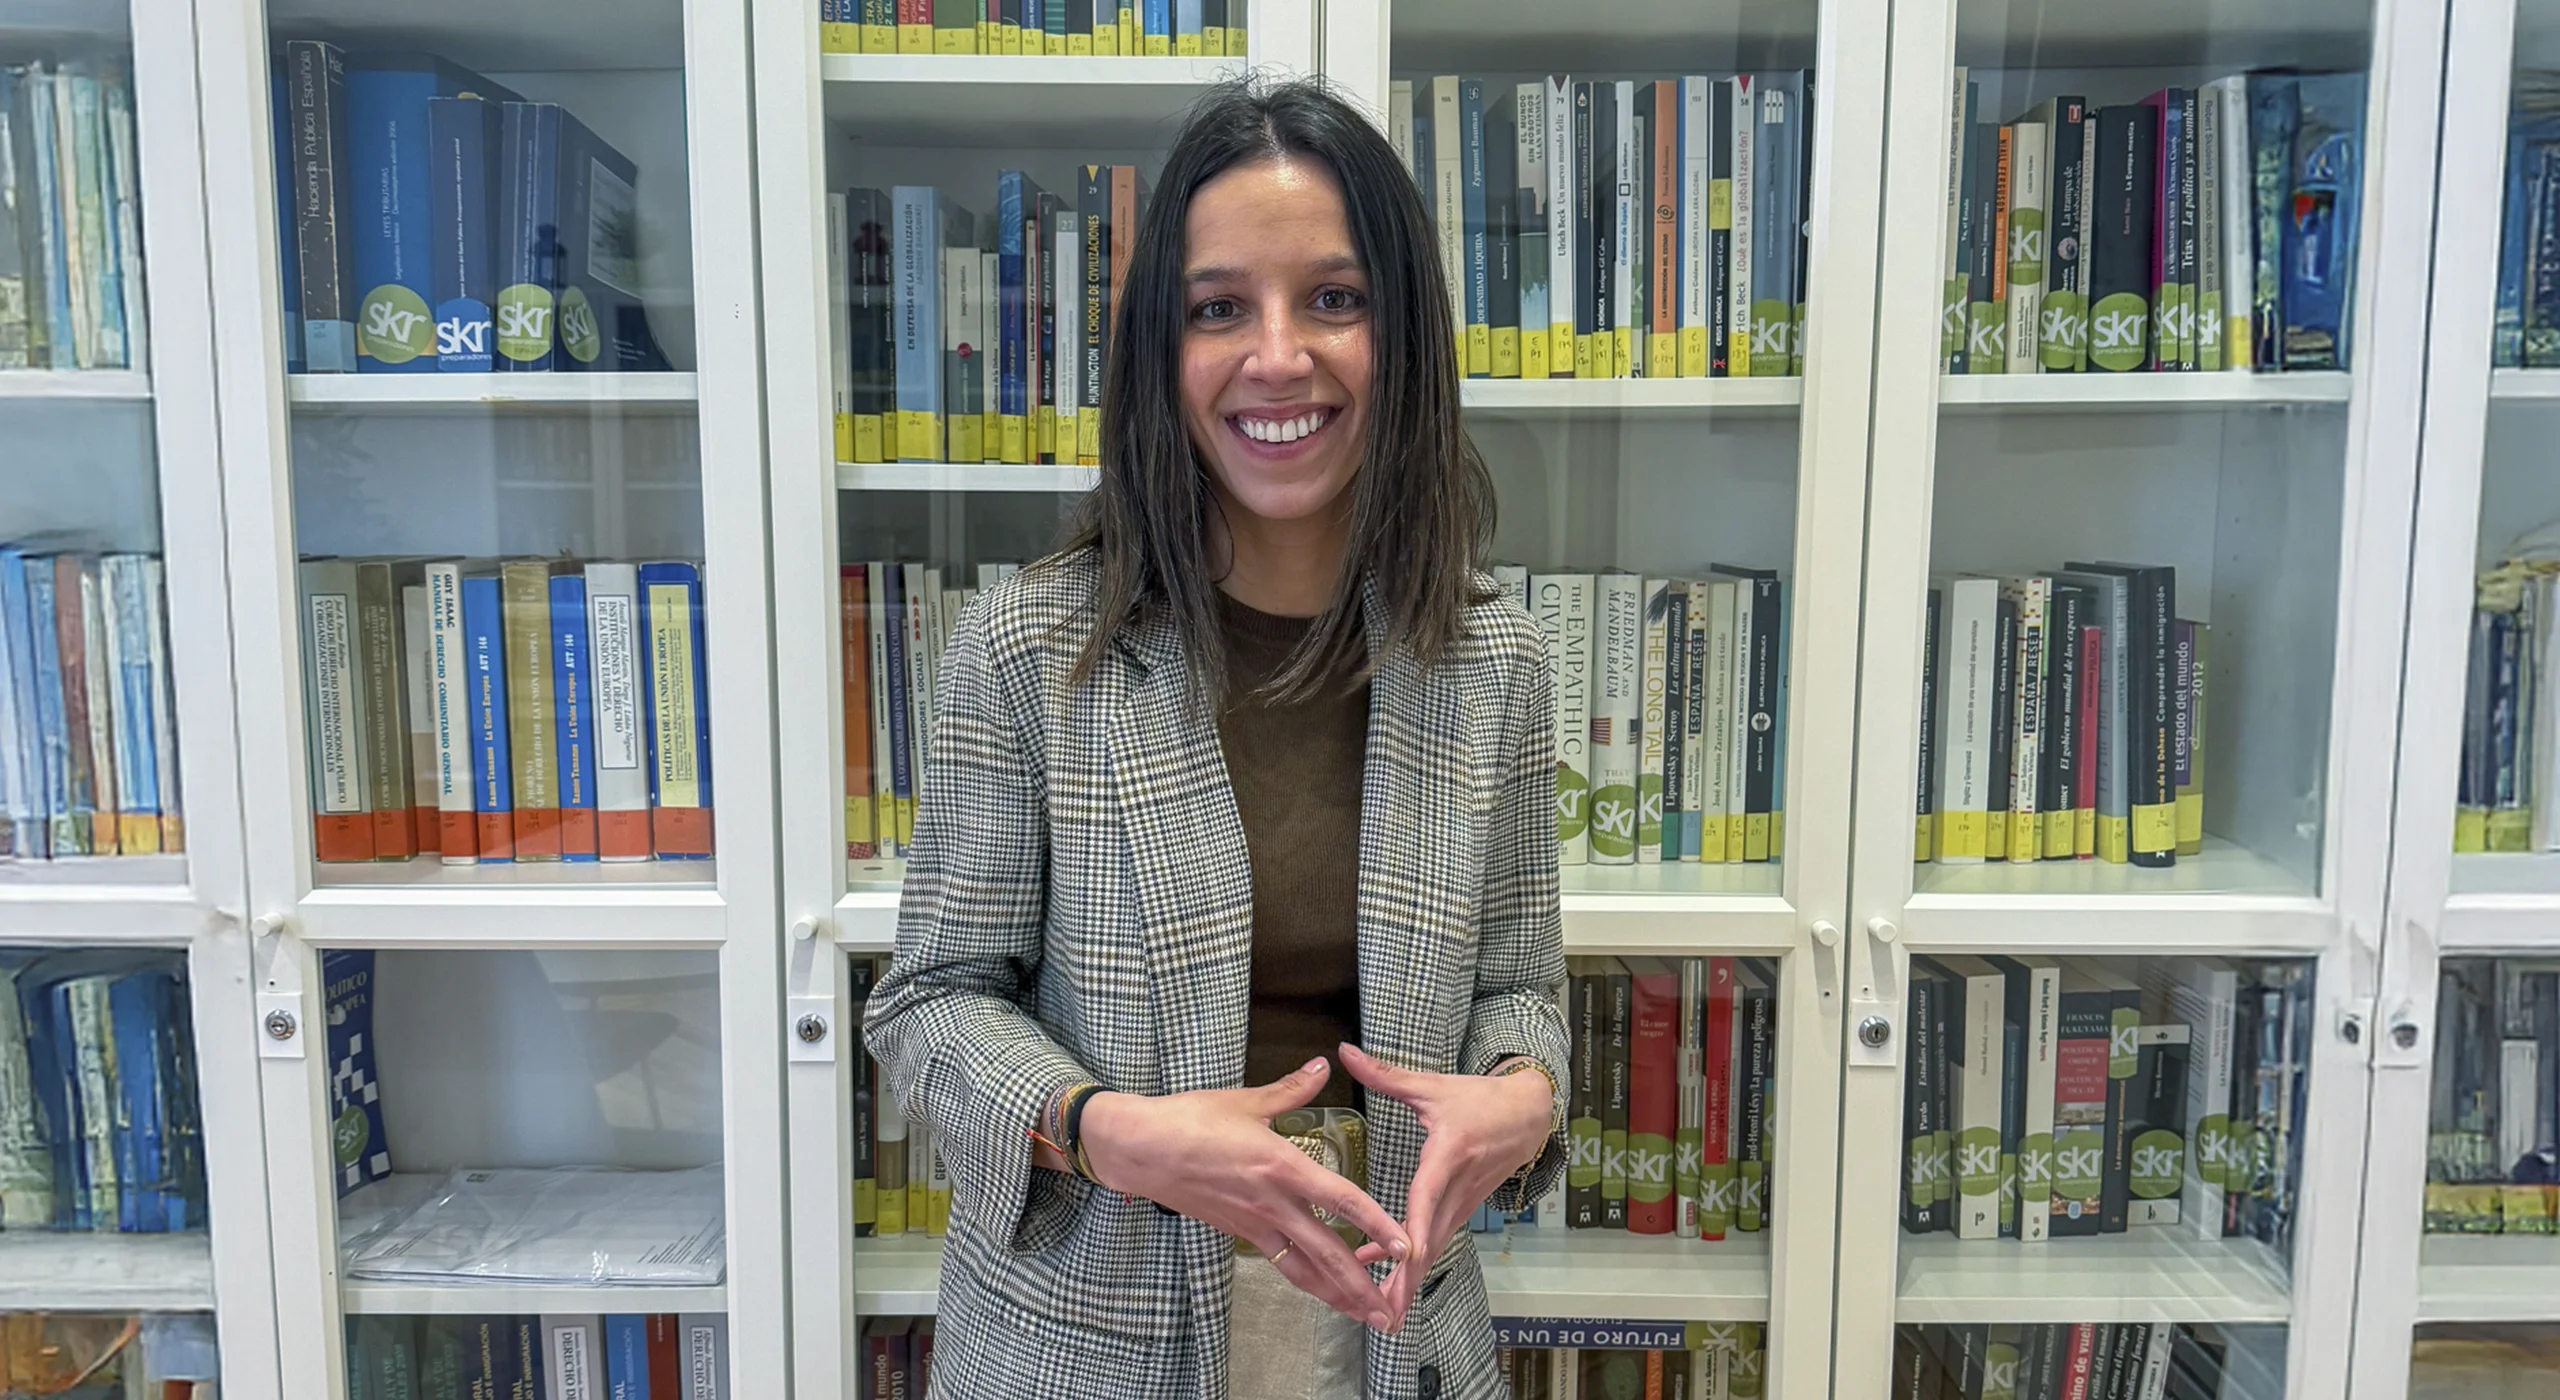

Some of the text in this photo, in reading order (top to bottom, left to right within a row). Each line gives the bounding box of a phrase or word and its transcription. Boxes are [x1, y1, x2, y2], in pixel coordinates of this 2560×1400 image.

[300, 51, 321, 218] Hacienda Pública Española
[1519, 94, 1527, 143] EL MUNDO
[1526, 94, 1534, 144] NOSOTROS
[2182, 99, 2194, 141] sombra
[2125, 121, 2136, 191] La Europa mestiza
[2184, 143, 2194, 155] su
[1088, 186, 1098, 195] 29
[1469, 111, 1485, 270] LÍQUIDA Zygmunt Bauman
[1555, 113, 1566, 256] Ulrich Beck Un nuevo mundo feliz
[2061, 165, 2074, 226] La trampa de
[2182, 167, 2195, 208] política
[1060, 219, 1074, 231] 27
[1620, 202, 1629, 225] España
[1735, 130, 1749, 304] Beck ¿Qué es la globalización?
[2183, 211, 2194, 225] La
[904, 203, 915, 350] EN DEFENSA DE LA GLOBALIZACIÓN
[1088, 214, 1100, 344] EL CHOQUE DE CIVILIZACIONES
[365, 301, 429, 343] skr
[436, 316, 492, 354] skr
[498, 302, 553, 338] skr
[563, 302, 590, 345] skr
[1714, 295, 1723, 345] CRISIS CRÓNICA
[2093, 309, 2146, 346] skr
[1087, 348, 1099, 404] HUNTINGTON
[444, 574, 455, 628] GUY ISAAC
[598, 601, 613, 712] DE LA UNIÓN EUROPEA
[608, 601, 621, 675] INSTITUCIONES
[1605, 588, 1620, 698] MANDELBAUM
[1622, 591, 1635, 672] FRIEDMAN
[1670, 601, 1682, 677] cultura-mundo
[2000, 616, 2010, 657] indiferencia
[2086, 639, 2098, 671] POLÍTICA
[2156, 585, 2167, 722] Comprender la inmigración
[315, 609, 329, 688] ORGANIZACIONES
[322, 690, 335, 773] INTERNACIONALES
[324, 600, 343, 759] CURSO DE DERECHO INTERNACIONAL
[432, 574, 452, 795] MANUAL DE DERECHO COMUNITARIO GENERAL
[915, 651, 925, 692] SOCIALES
[1563, 584, 1585, 756] THE EMPATHIC
[1645, 623, 1665, 765] THE LONG TAIL
[1670, 681, 1680, 695] La
[1689, 632, 1704, 730] ESPAÑA RESET
[1999, 667, 2008, 691] Contra
[2024, 630, 2039, 729] ESPAÑA RESET
[2060, 599, 2076, 770] El gobierno mundial de los expertos
[2192, 661, 2204, 696] 2012
[612, 686, 623, 732] DERECHO
[658, 628, 674, 781] POLÍTICAS DE LA UNIÓN EUROPEA
[892, 645, 906, 785] LA GOBERNABILIDAD EN UN MUNDO EN
[1667, 708, 1680, 741] Serroy
[2175, 641, 2188, 756] estado del mundo
[376, 714, 388, 774] INTERNACIONAL
[1712, 709, 1725, 807] José Antonio Zarzalejos
[1665, 754, 1678, 806] Lipovetsky
[1750, 998, 1765, 1088] La pureza peligrosa
[2060, 1024, 2110, 1035] FUKUYAMA
[2065, 1013, 2105, 1022] FRANCIS
[1582, 1015, 1592, 1092] La del
[1610, 1023, 1623, 1109] Lipovetsky De la
[1917, 988, 1929, 1130] Pardo Estudios del malestar
[1628, 1149, 1673, 1183] skr
[1955, 1142, 2001, 1176] skr
[2055, 1144, 2104, 1178] skr
[2131, 1144, 2184, 1178] skr
[562, 1331, 576, 1386] DERECHO
[690, 1330, 705, 1384] DERECHO
[1518, 1328, 1681, 1346] FUTURO DE UN
[2107, 1327, 2130, 1399] Contra el tiempo
[2131, 1325, 2147, 1358] funeral
[877, 1354, 887, 1395] mundo
[2073, 1357, 2087, 1373] de
